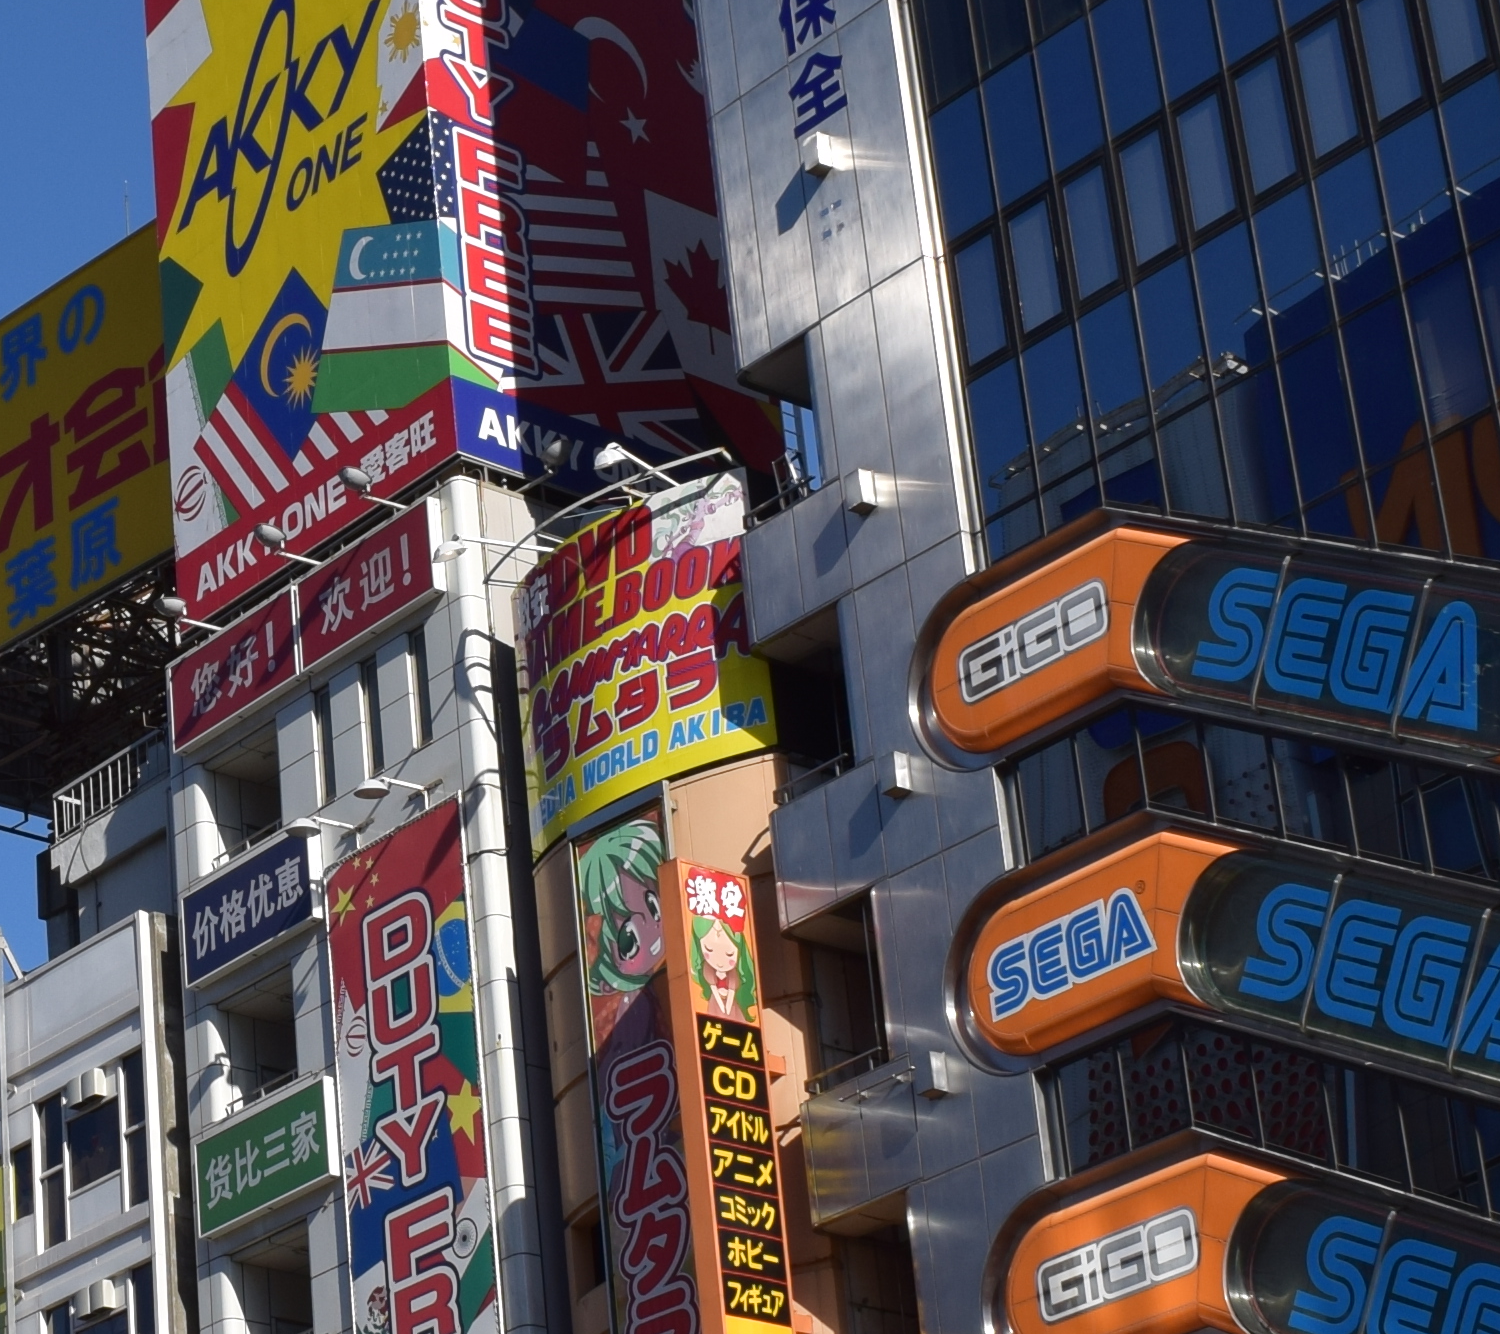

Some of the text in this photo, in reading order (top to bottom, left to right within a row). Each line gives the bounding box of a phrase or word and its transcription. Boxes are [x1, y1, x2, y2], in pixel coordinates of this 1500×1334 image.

[286, 112, 369, 213] ONE
[451, 128, 540, 379] FREE
[281, 479, 348, 538] ONE
[320, 527, 413, 635] 欢迎!
[550, 504, 653, 618] DVD
[190, 622, 278, 720] 您好!
[1191, 564, 1480, 731] SEGA
[540, 647, 720, 784] ラムタラ
[582, 696, 767, 795] WORLD AKIBA
[190, 857, 304, 963] 价格优惠
[685, 872, 746, 919] 激安
[989, 886, 1160, 1023] SEGA
[360, 888, 447, 1191] DUTY
[702, 1022, 760, 1062] ゲーム
[711, 1066, 757, 1101] CD
[204, 1107, 321, 1200] 货比三家
[709, 1107, 770, 1144] アイドル
[712, 1150, 775, 1188] アニメ
[718, 1197, 777, 1232] コミック
[726, 1238, 780, 1270] ホビー
[727, 1280, 785, 1320] フィギュア
